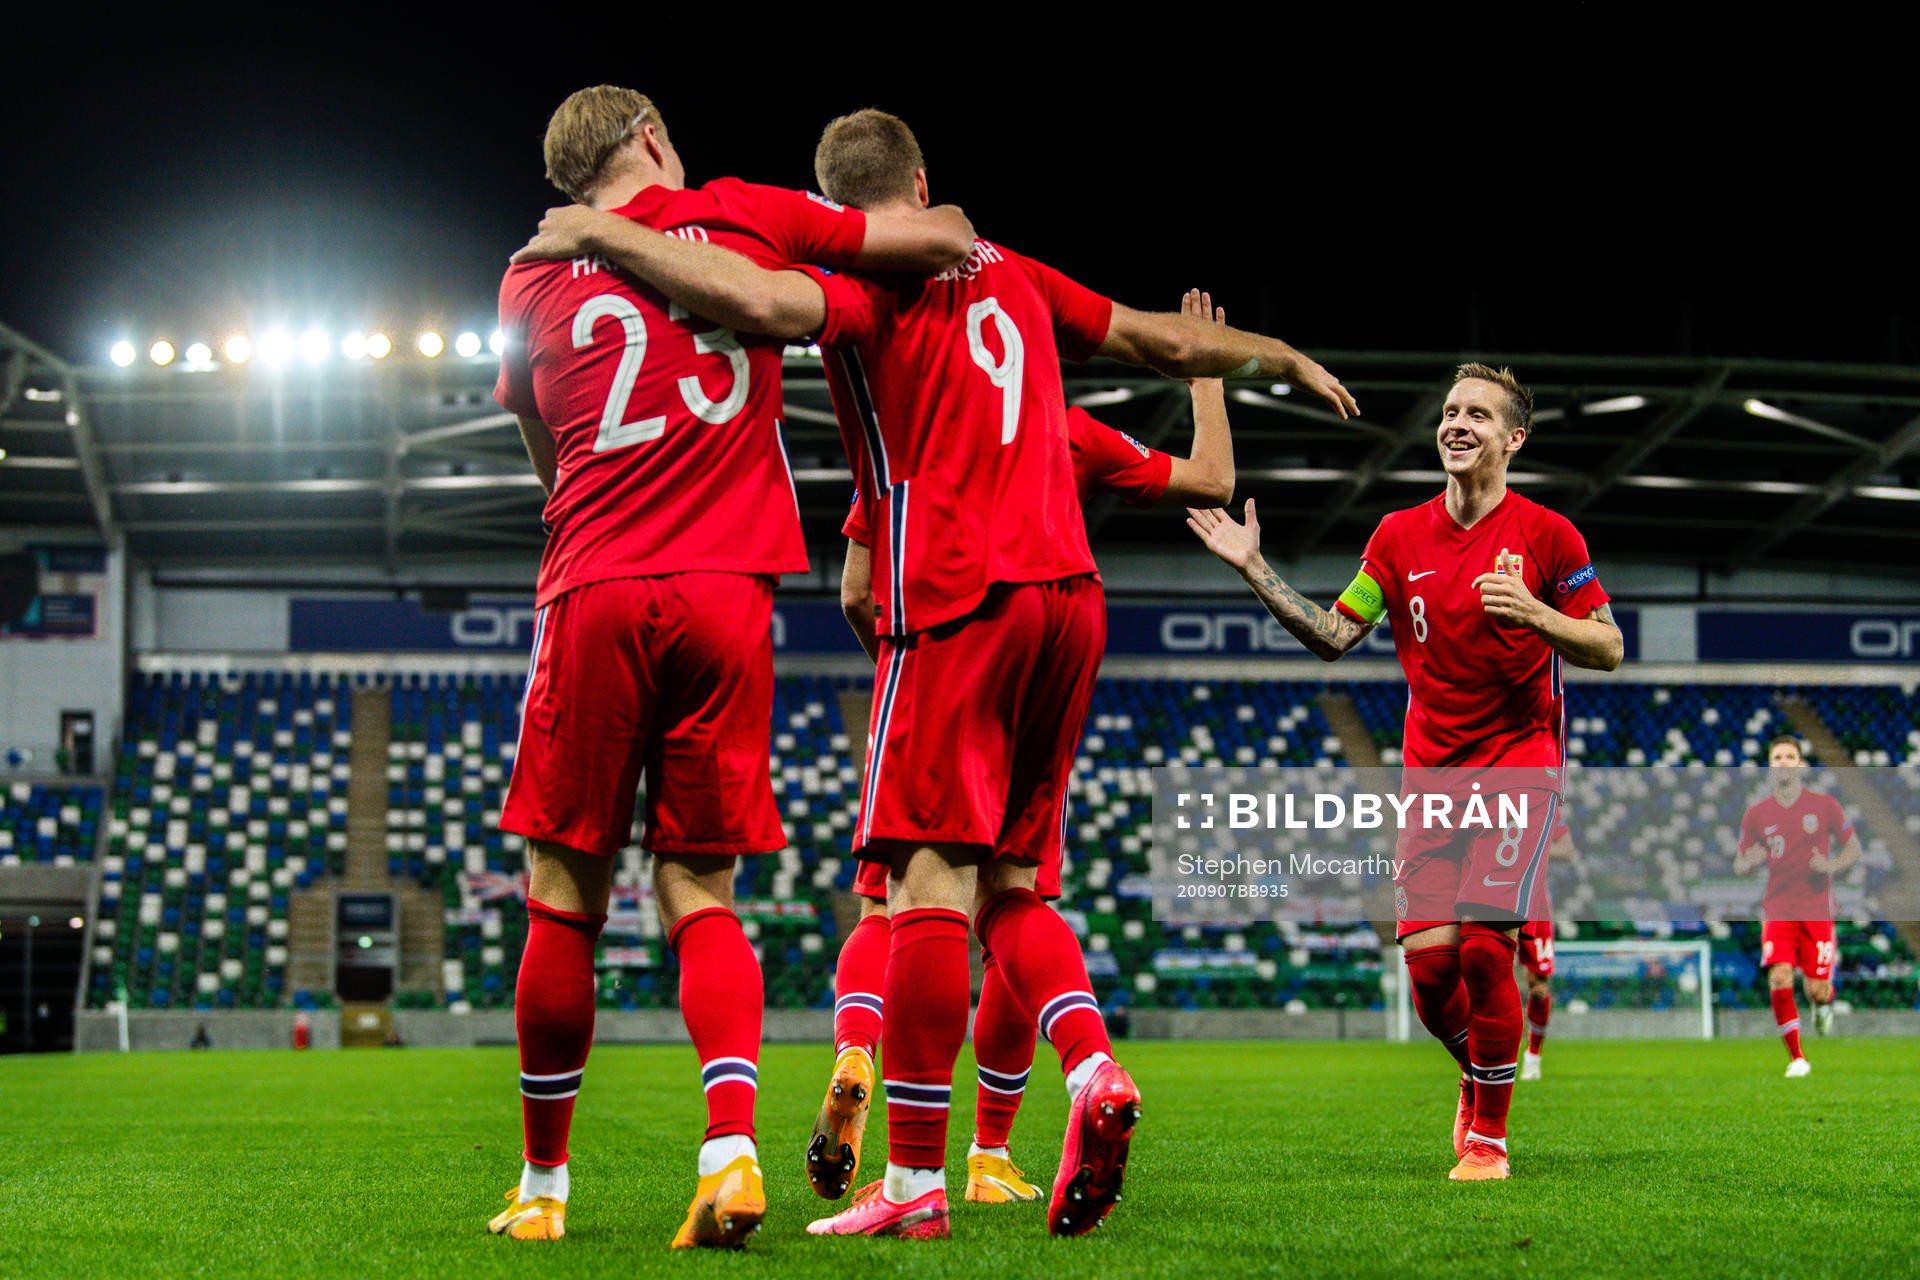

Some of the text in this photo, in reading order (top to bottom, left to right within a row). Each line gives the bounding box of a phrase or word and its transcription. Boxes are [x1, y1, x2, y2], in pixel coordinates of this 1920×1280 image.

[571, 293, 751, 454] 23
[966, 296, 1025, 446] 9
[1567, 566, 1594, 587] RESPECT
[1409, 595, 1429, 643] 8
[1495, 820, 1524, 867] 8
